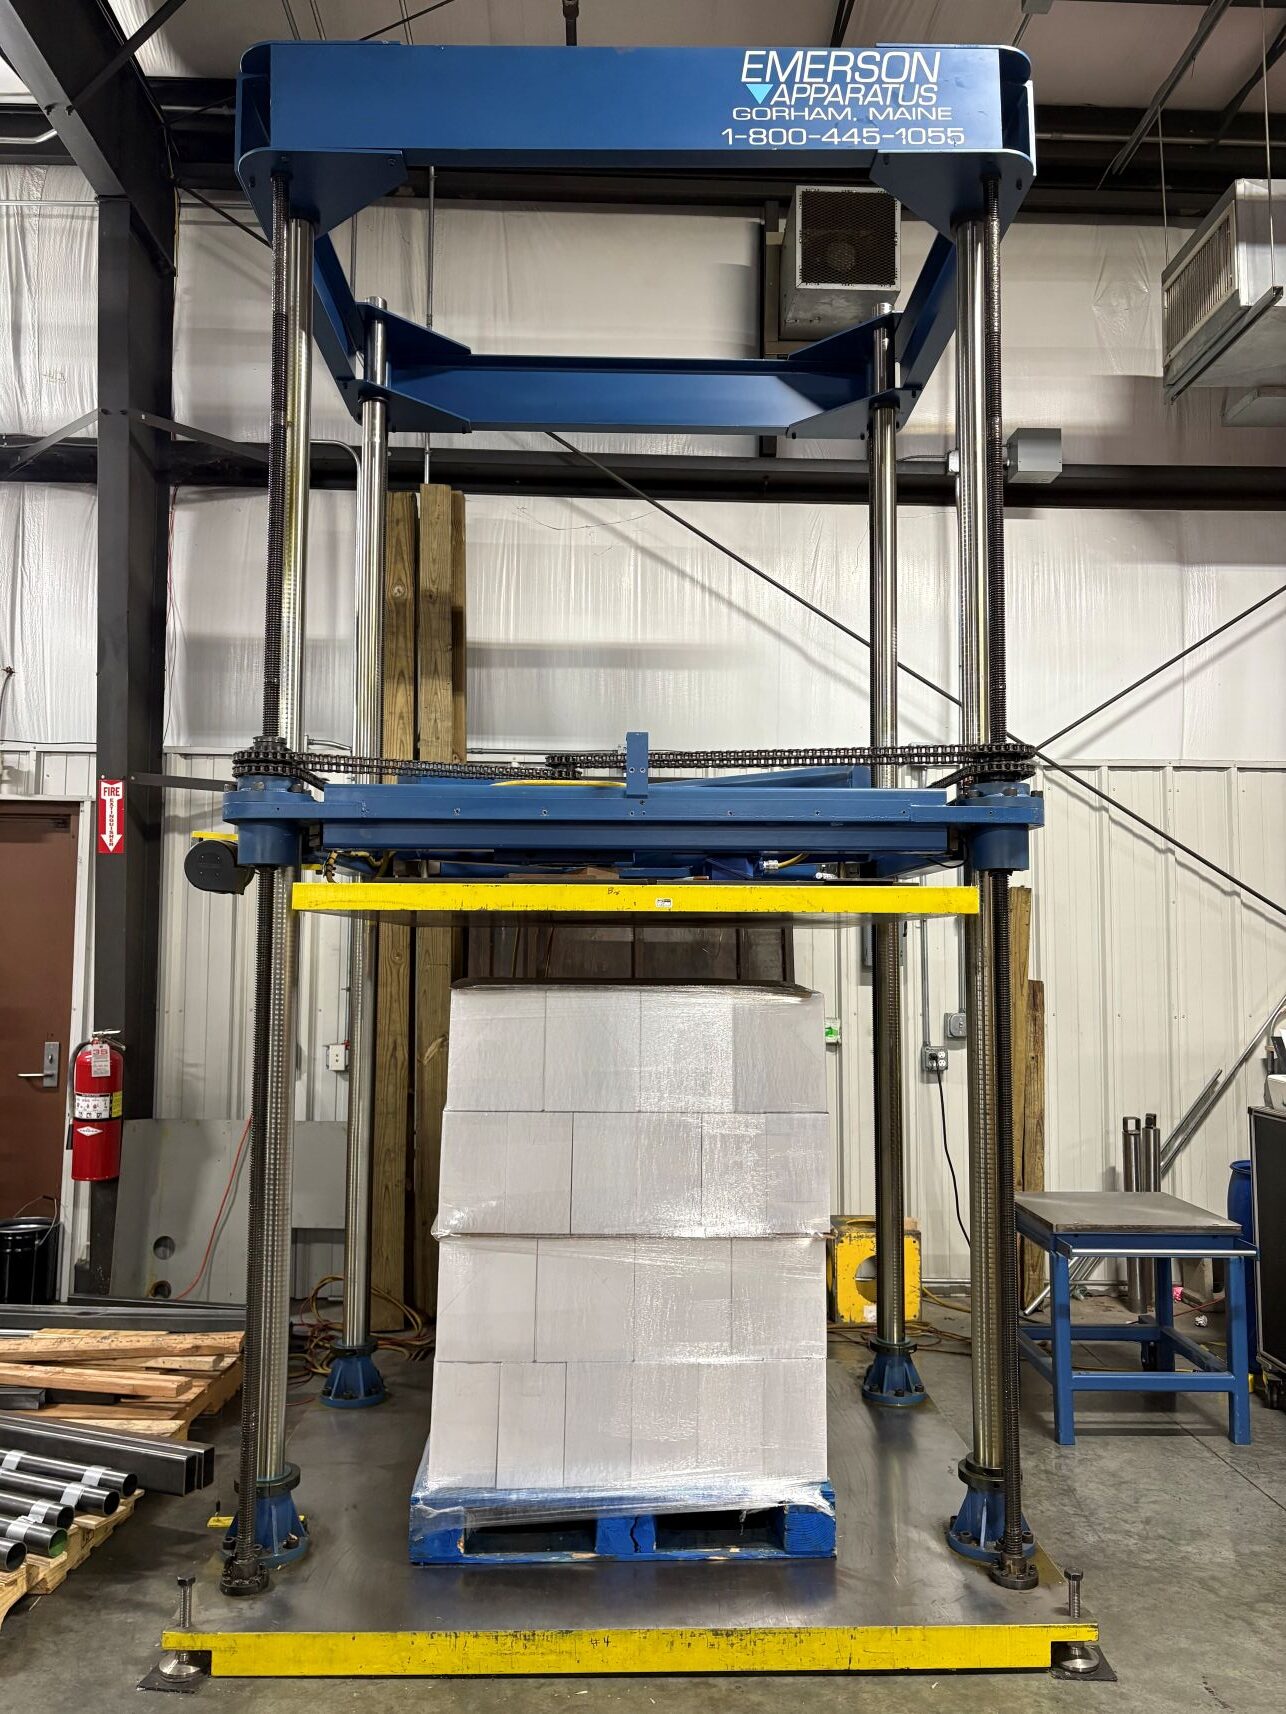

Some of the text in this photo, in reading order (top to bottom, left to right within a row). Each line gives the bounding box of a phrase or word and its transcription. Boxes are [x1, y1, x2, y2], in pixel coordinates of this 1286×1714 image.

[741, 51, 941, 83] EMERSON
[770, 84, 938, 105] APPARATUS
[732, 107, 952, 122] GORHAM, MAINE
[721, 127, 965, 146] 1-800-445-1055
[103, 786, 121, 797] FIRE
